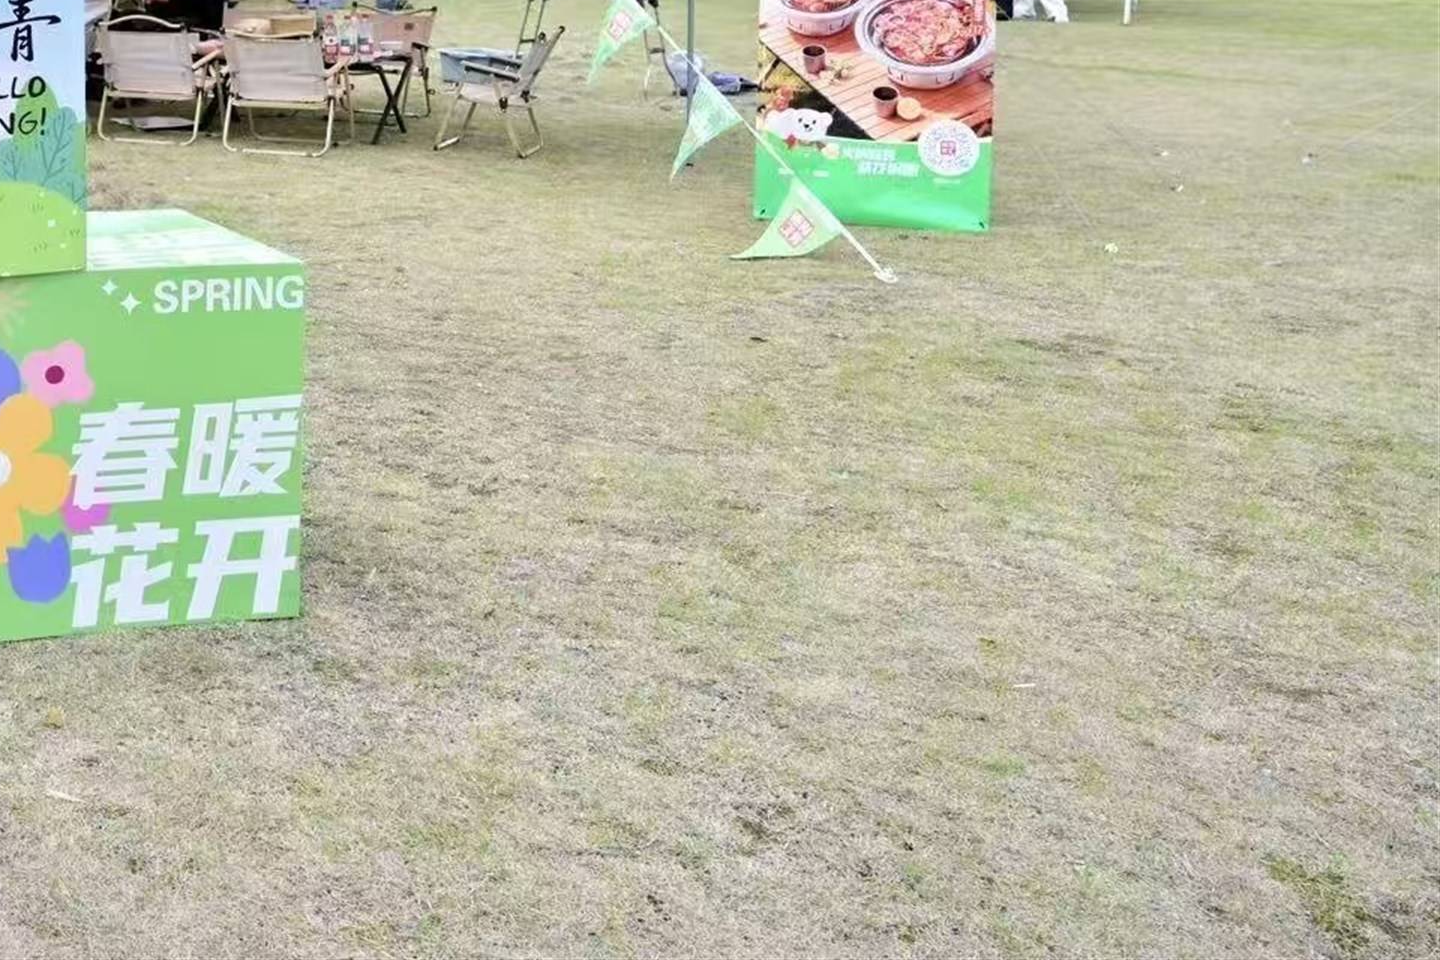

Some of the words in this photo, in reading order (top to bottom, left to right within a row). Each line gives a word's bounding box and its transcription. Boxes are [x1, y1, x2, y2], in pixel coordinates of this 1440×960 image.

[153, 275, 304, 314] SPRING
[69, 394, 304, 511] 春暖
[70, 514, 300, 628] 花开
